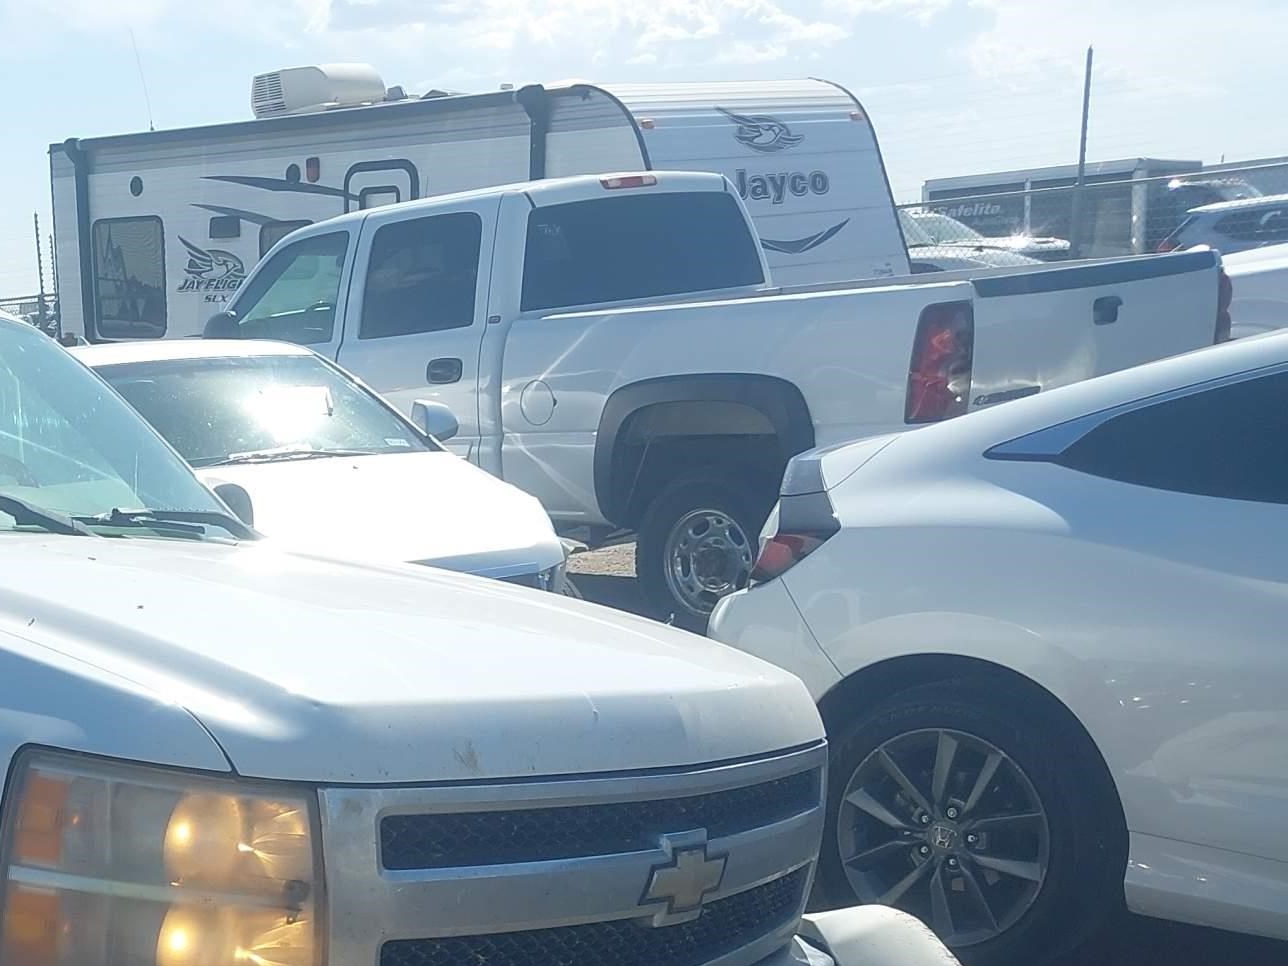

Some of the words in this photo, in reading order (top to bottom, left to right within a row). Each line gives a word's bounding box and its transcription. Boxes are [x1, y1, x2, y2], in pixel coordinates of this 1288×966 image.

[735, 168, 830, 205] Jayco
[176, 278, 205, 291] JAY
[203, 294, 229, 303] SLX
